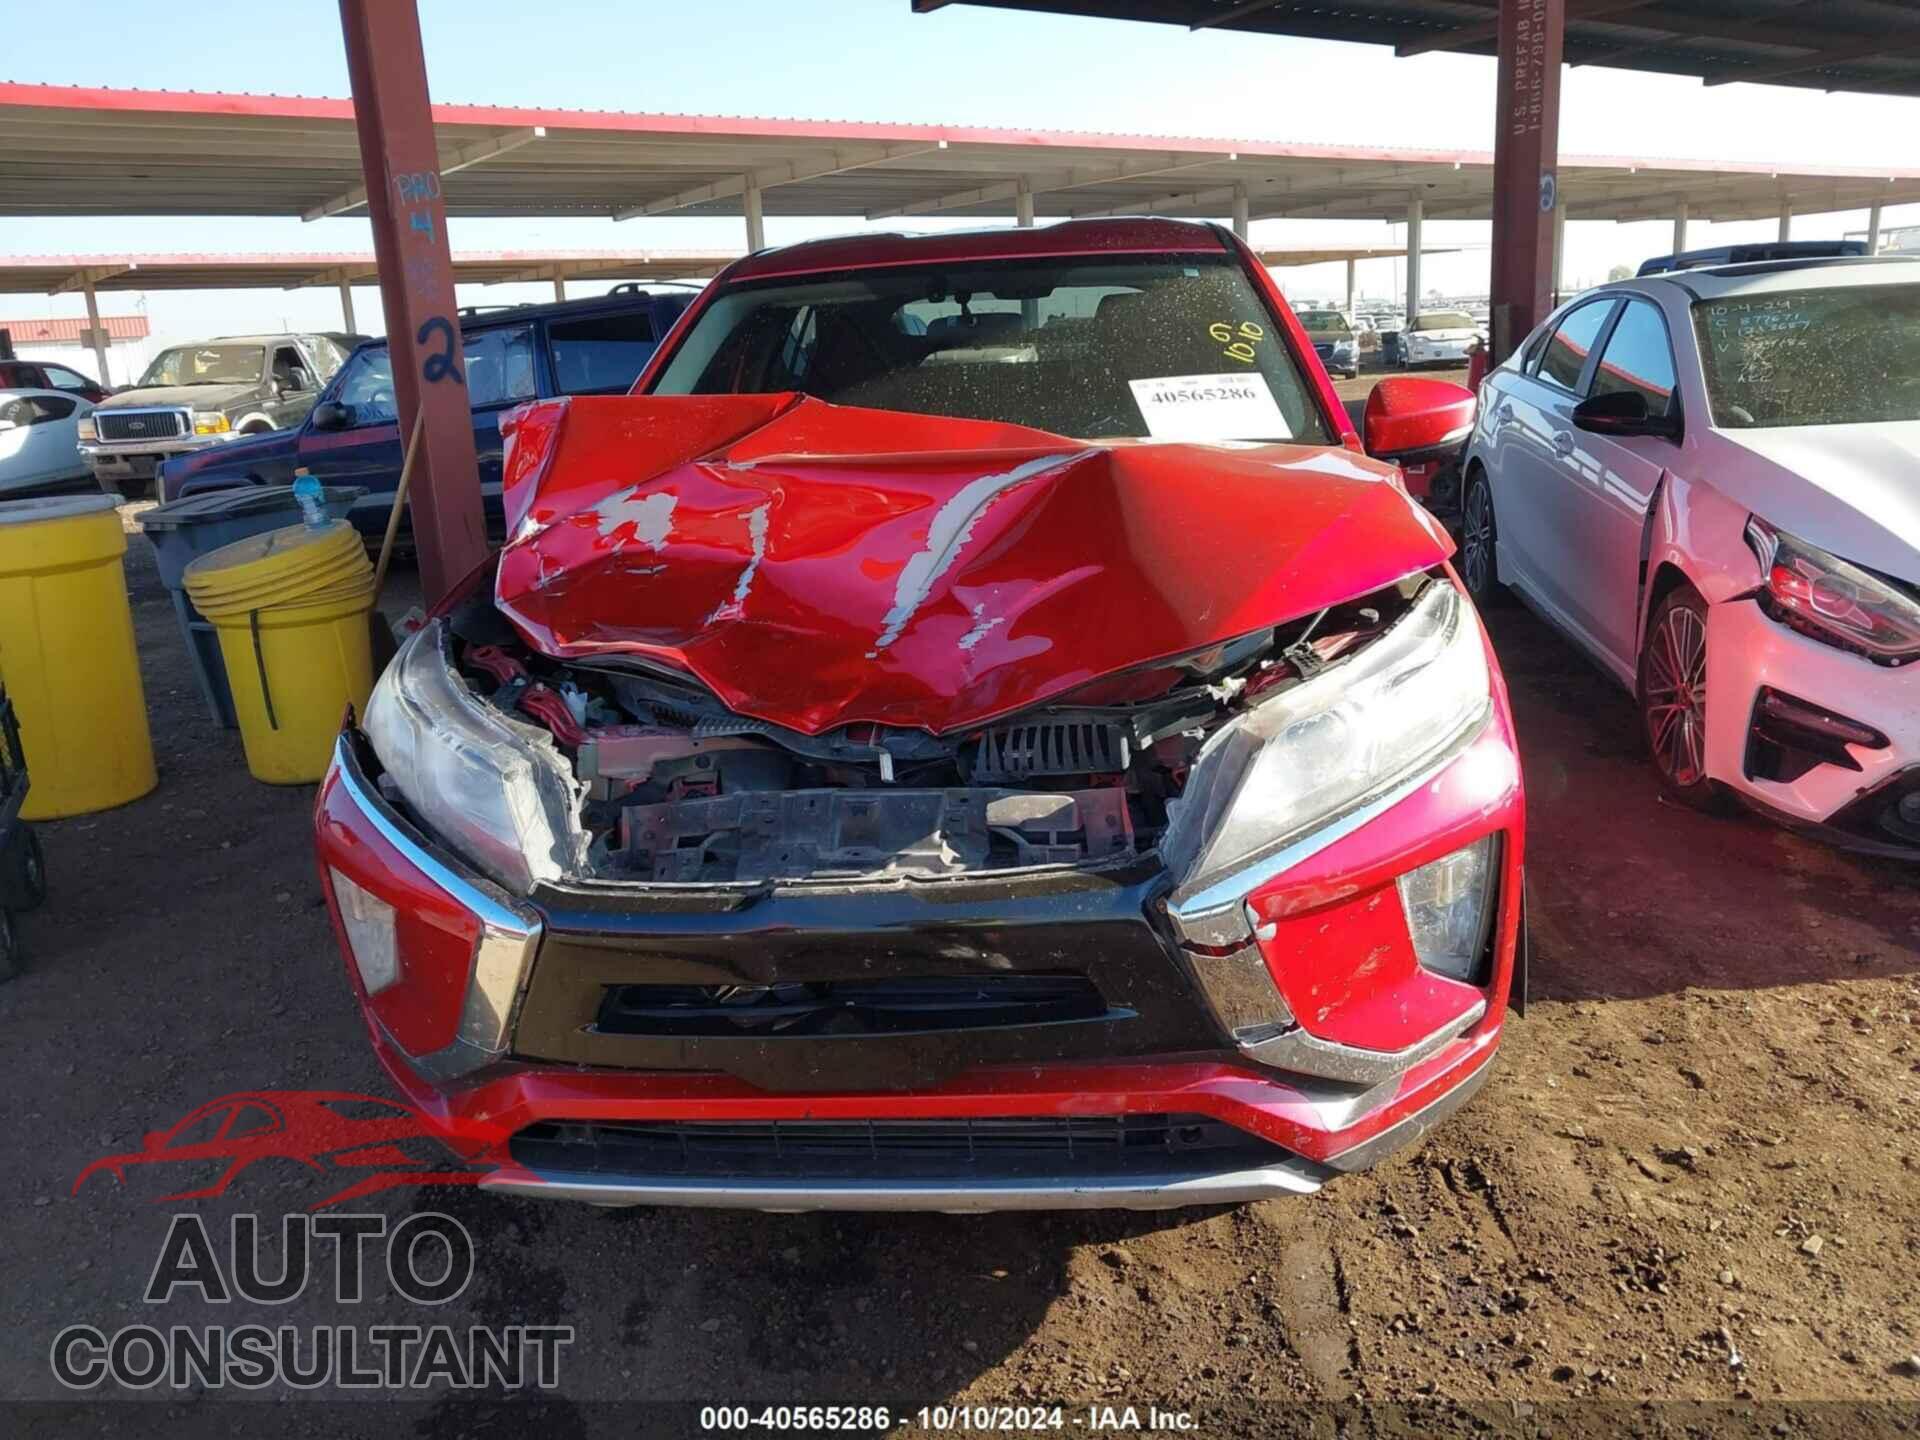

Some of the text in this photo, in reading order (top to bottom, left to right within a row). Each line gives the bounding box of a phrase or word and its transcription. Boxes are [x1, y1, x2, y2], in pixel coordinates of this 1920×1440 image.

[1514, 19, 1531, 91] PREFAB
[416, 316, 463, 384] 2
[1151, 387, 1256, 404] 40565286
